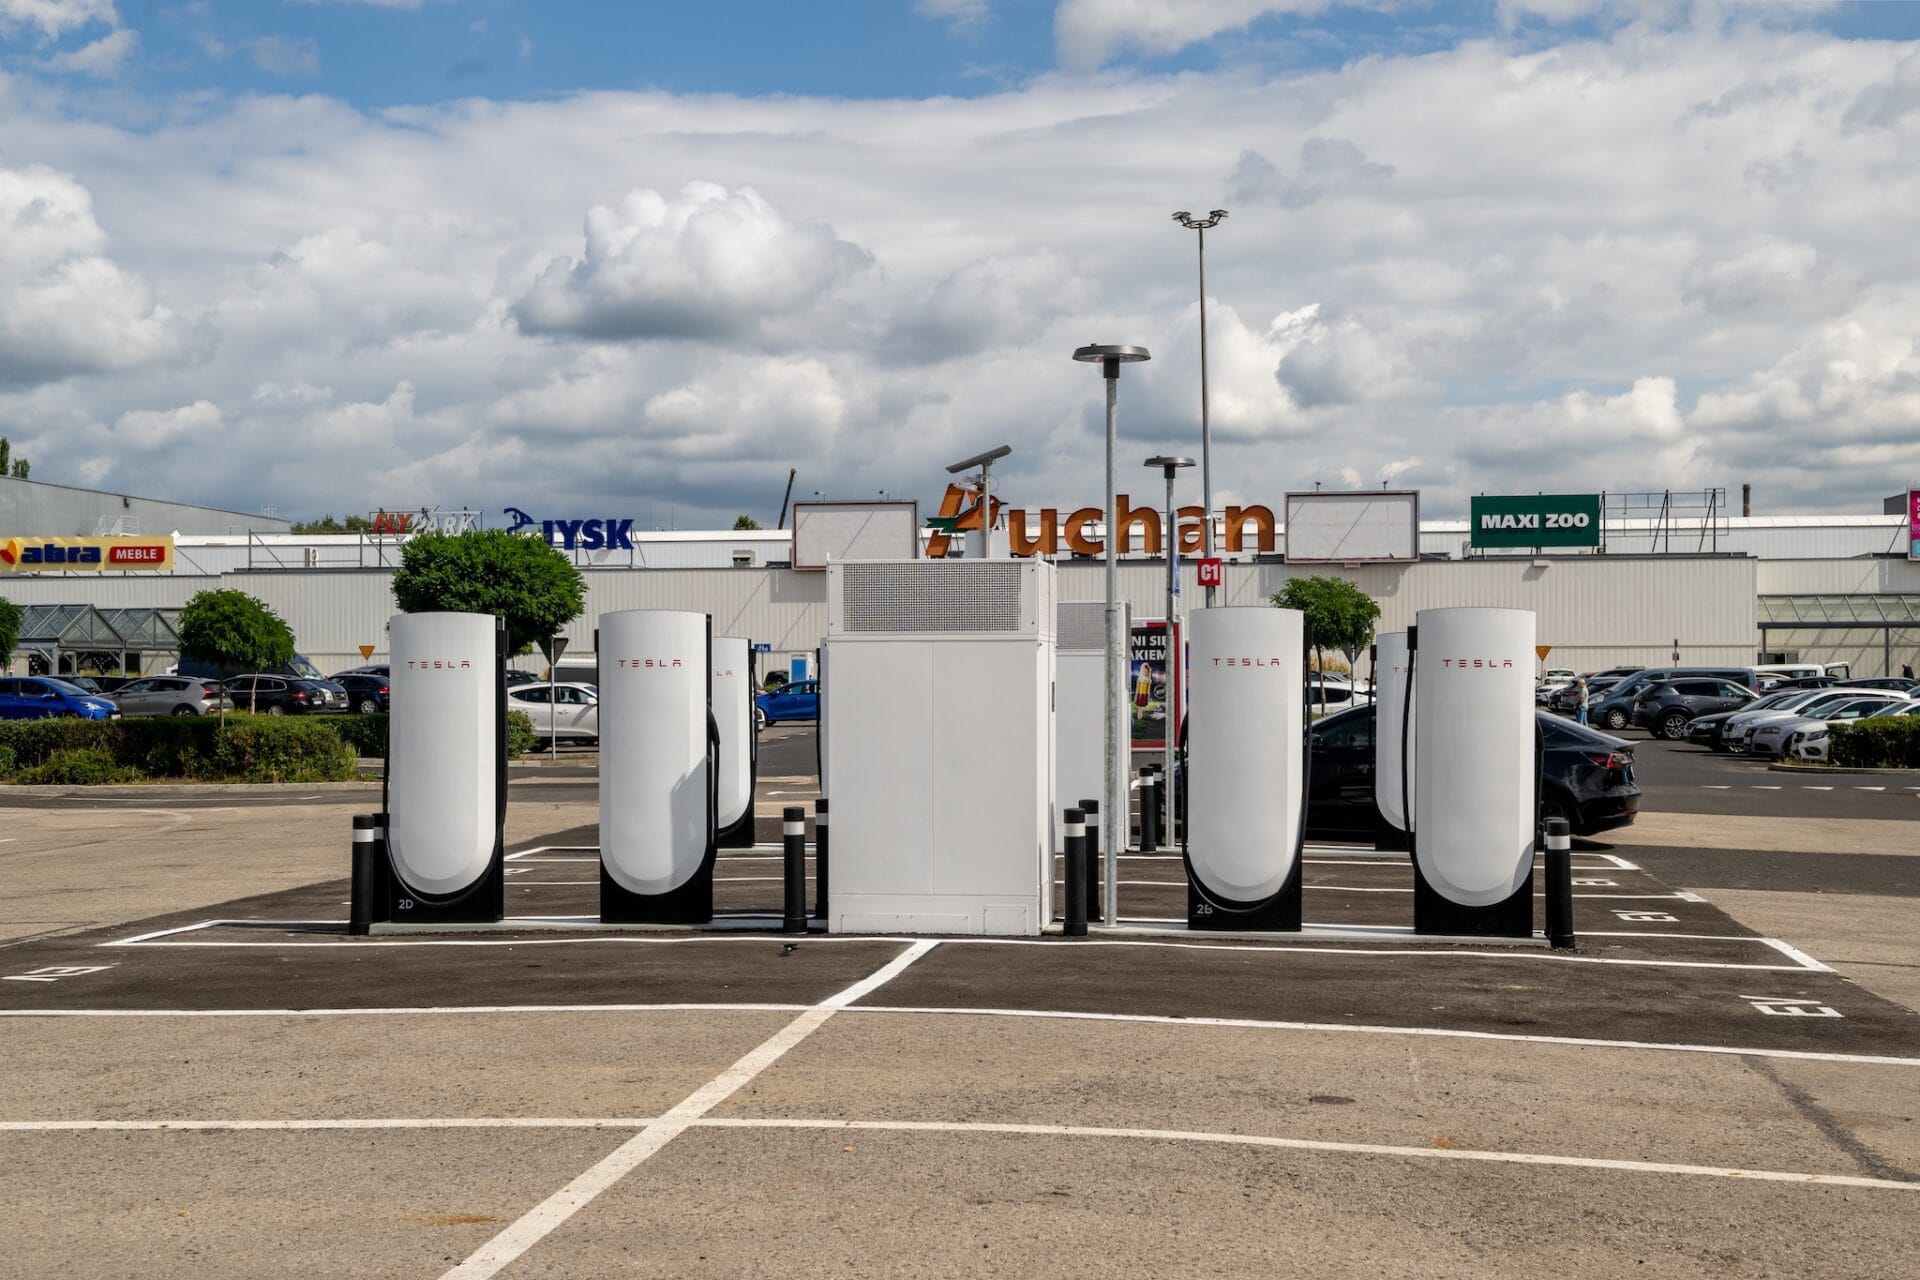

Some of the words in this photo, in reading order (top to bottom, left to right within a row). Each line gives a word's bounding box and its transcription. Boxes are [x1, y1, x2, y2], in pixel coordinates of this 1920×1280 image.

[1481, 514, 1539, 529] MAXI
[1545, 513, 1590, 528] ZOO
[21, 543, 101, 563] abra
[116, 549, 157, 560] MEBLE
[1201, 564, 1219, 580] C1
[408, 660, 470, 669] TESLA
[618, 659, 682, 668] TESLA
[1212, 658, 1280, 666] TESLA
[1443, 659, 1513, 668] TESLA
[398, 899, 414, 909] 2D
[1196, 904, 1213, 914] 2B
